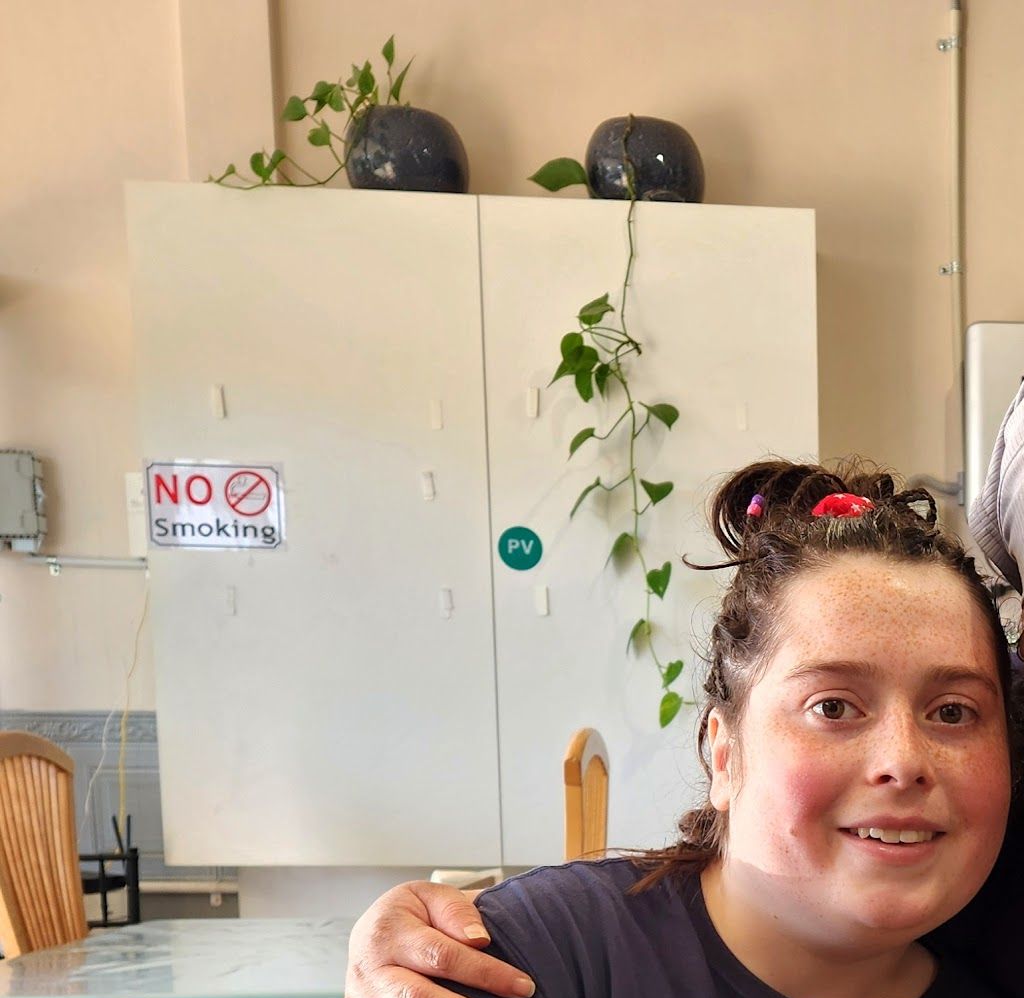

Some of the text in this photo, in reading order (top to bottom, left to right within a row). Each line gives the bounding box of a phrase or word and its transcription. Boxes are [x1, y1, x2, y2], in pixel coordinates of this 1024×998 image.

[154, 473, 213, 505] NO
[154, 517, 276, 545] Smoking
[507, 538, 534, 555] PV
